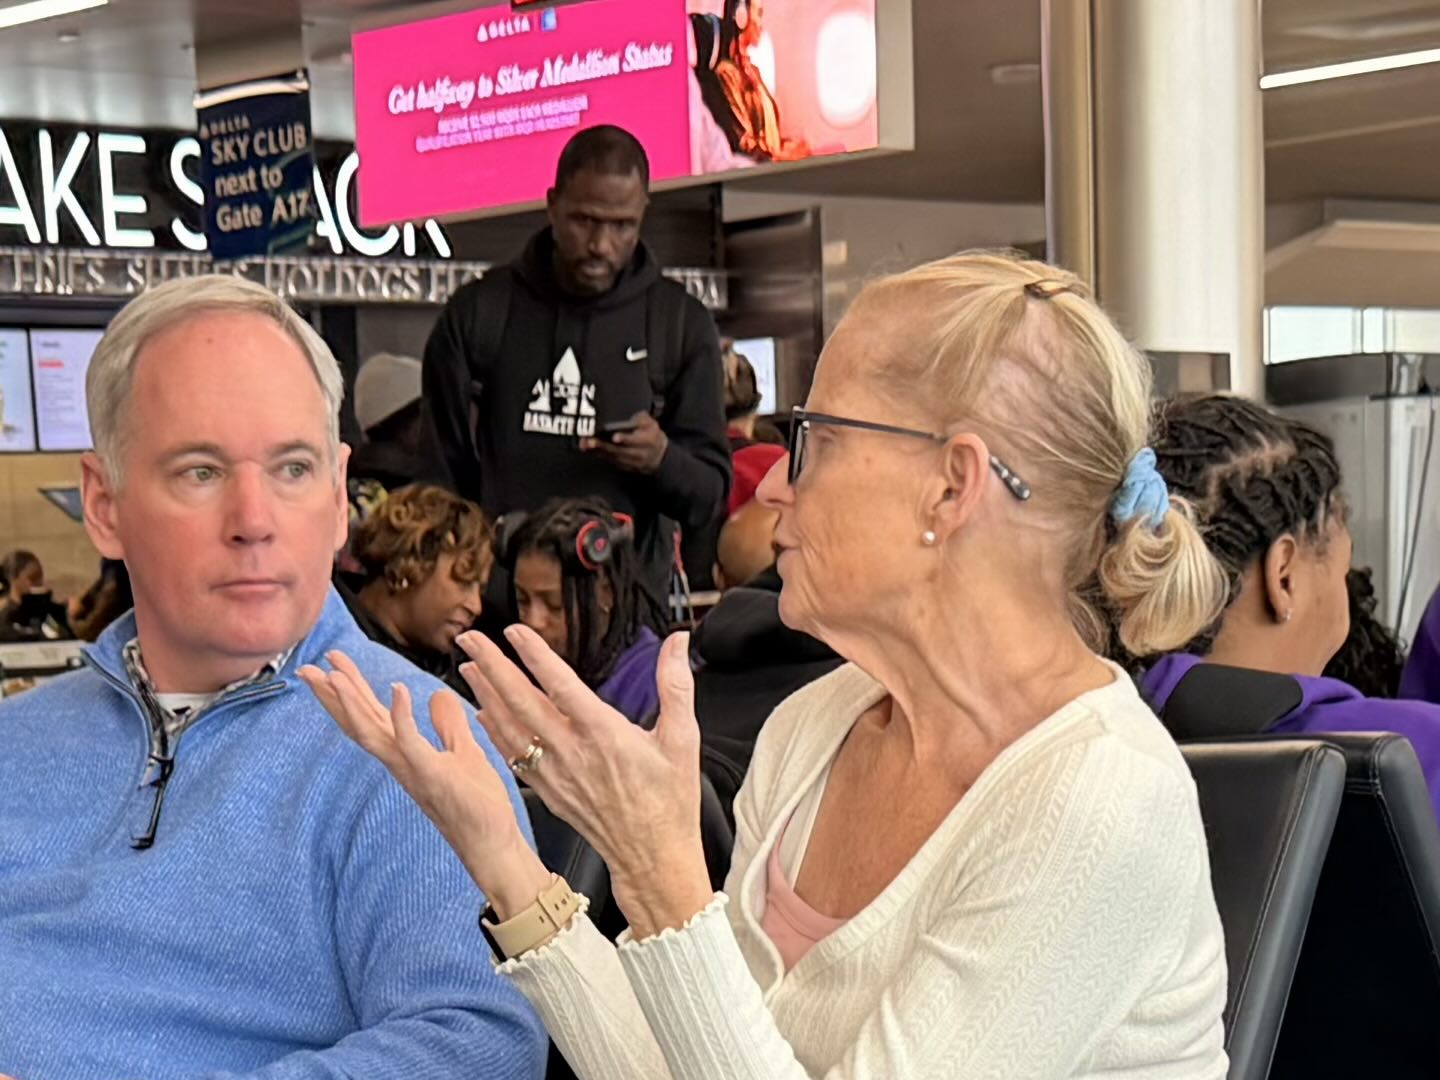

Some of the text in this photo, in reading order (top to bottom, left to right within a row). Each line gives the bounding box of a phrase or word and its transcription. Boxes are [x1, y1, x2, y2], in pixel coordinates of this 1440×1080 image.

[211, 114, 251, 136] DELTA
[212, 121, 307, 166] SKY CLUB
[215, 163, 284, 198] next to
[216, 190, 310, 232] Gate A17
[335, 258, 421, 302] DOGS
